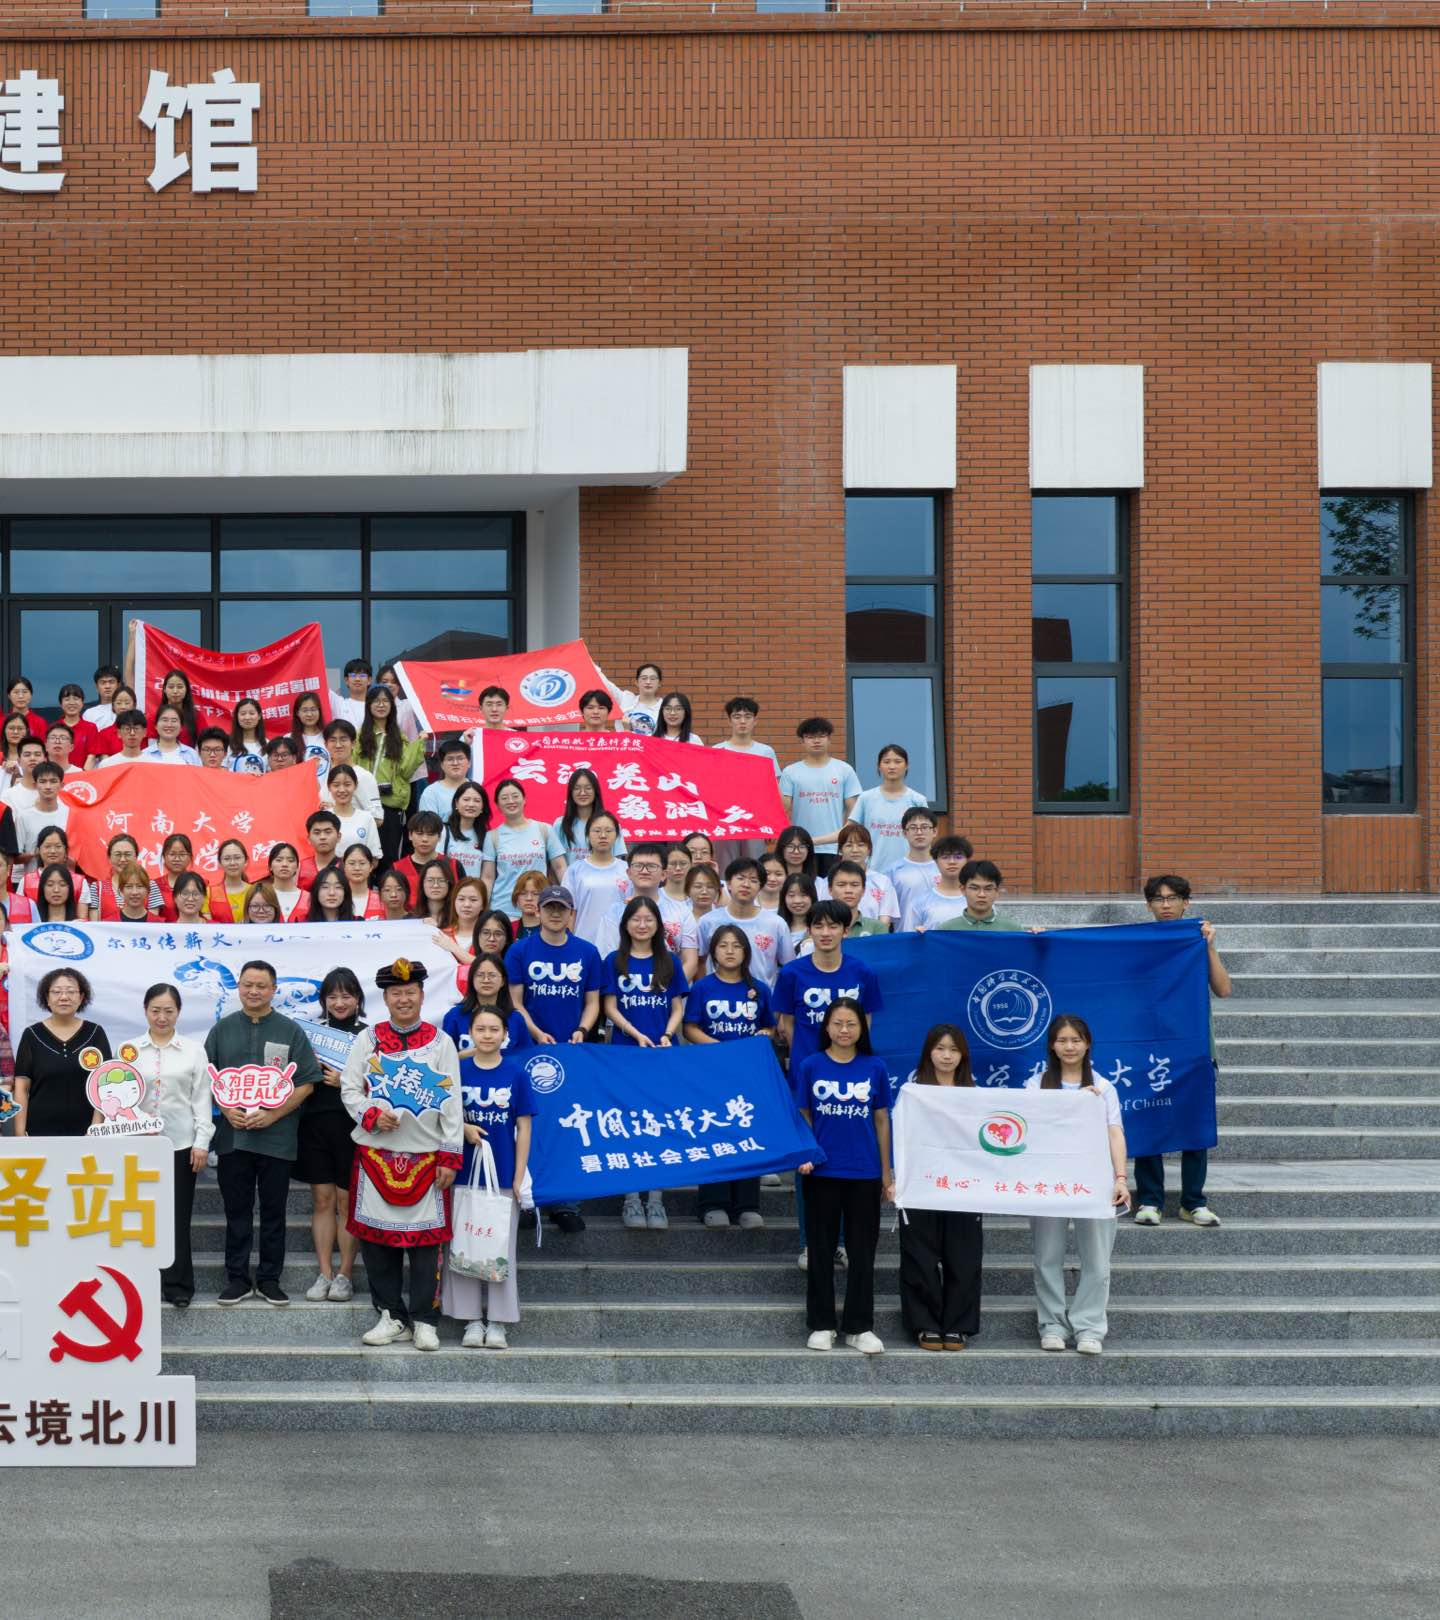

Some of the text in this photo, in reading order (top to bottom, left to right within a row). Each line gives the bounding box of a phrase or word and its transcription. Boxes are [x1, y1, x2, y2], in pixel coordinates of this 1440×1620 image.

[105, 808, 255, 835] 河南大学
[228, 1074, 270, 1088] 为自己
[1133, 1096, 1172, 1111] China
[559, 1094, 756, 1148] 中国海洋大学
[579, 1136, 766, 1175] 暑期社会实践队
[993, 1180, 1093, 1195] 社会实践队
